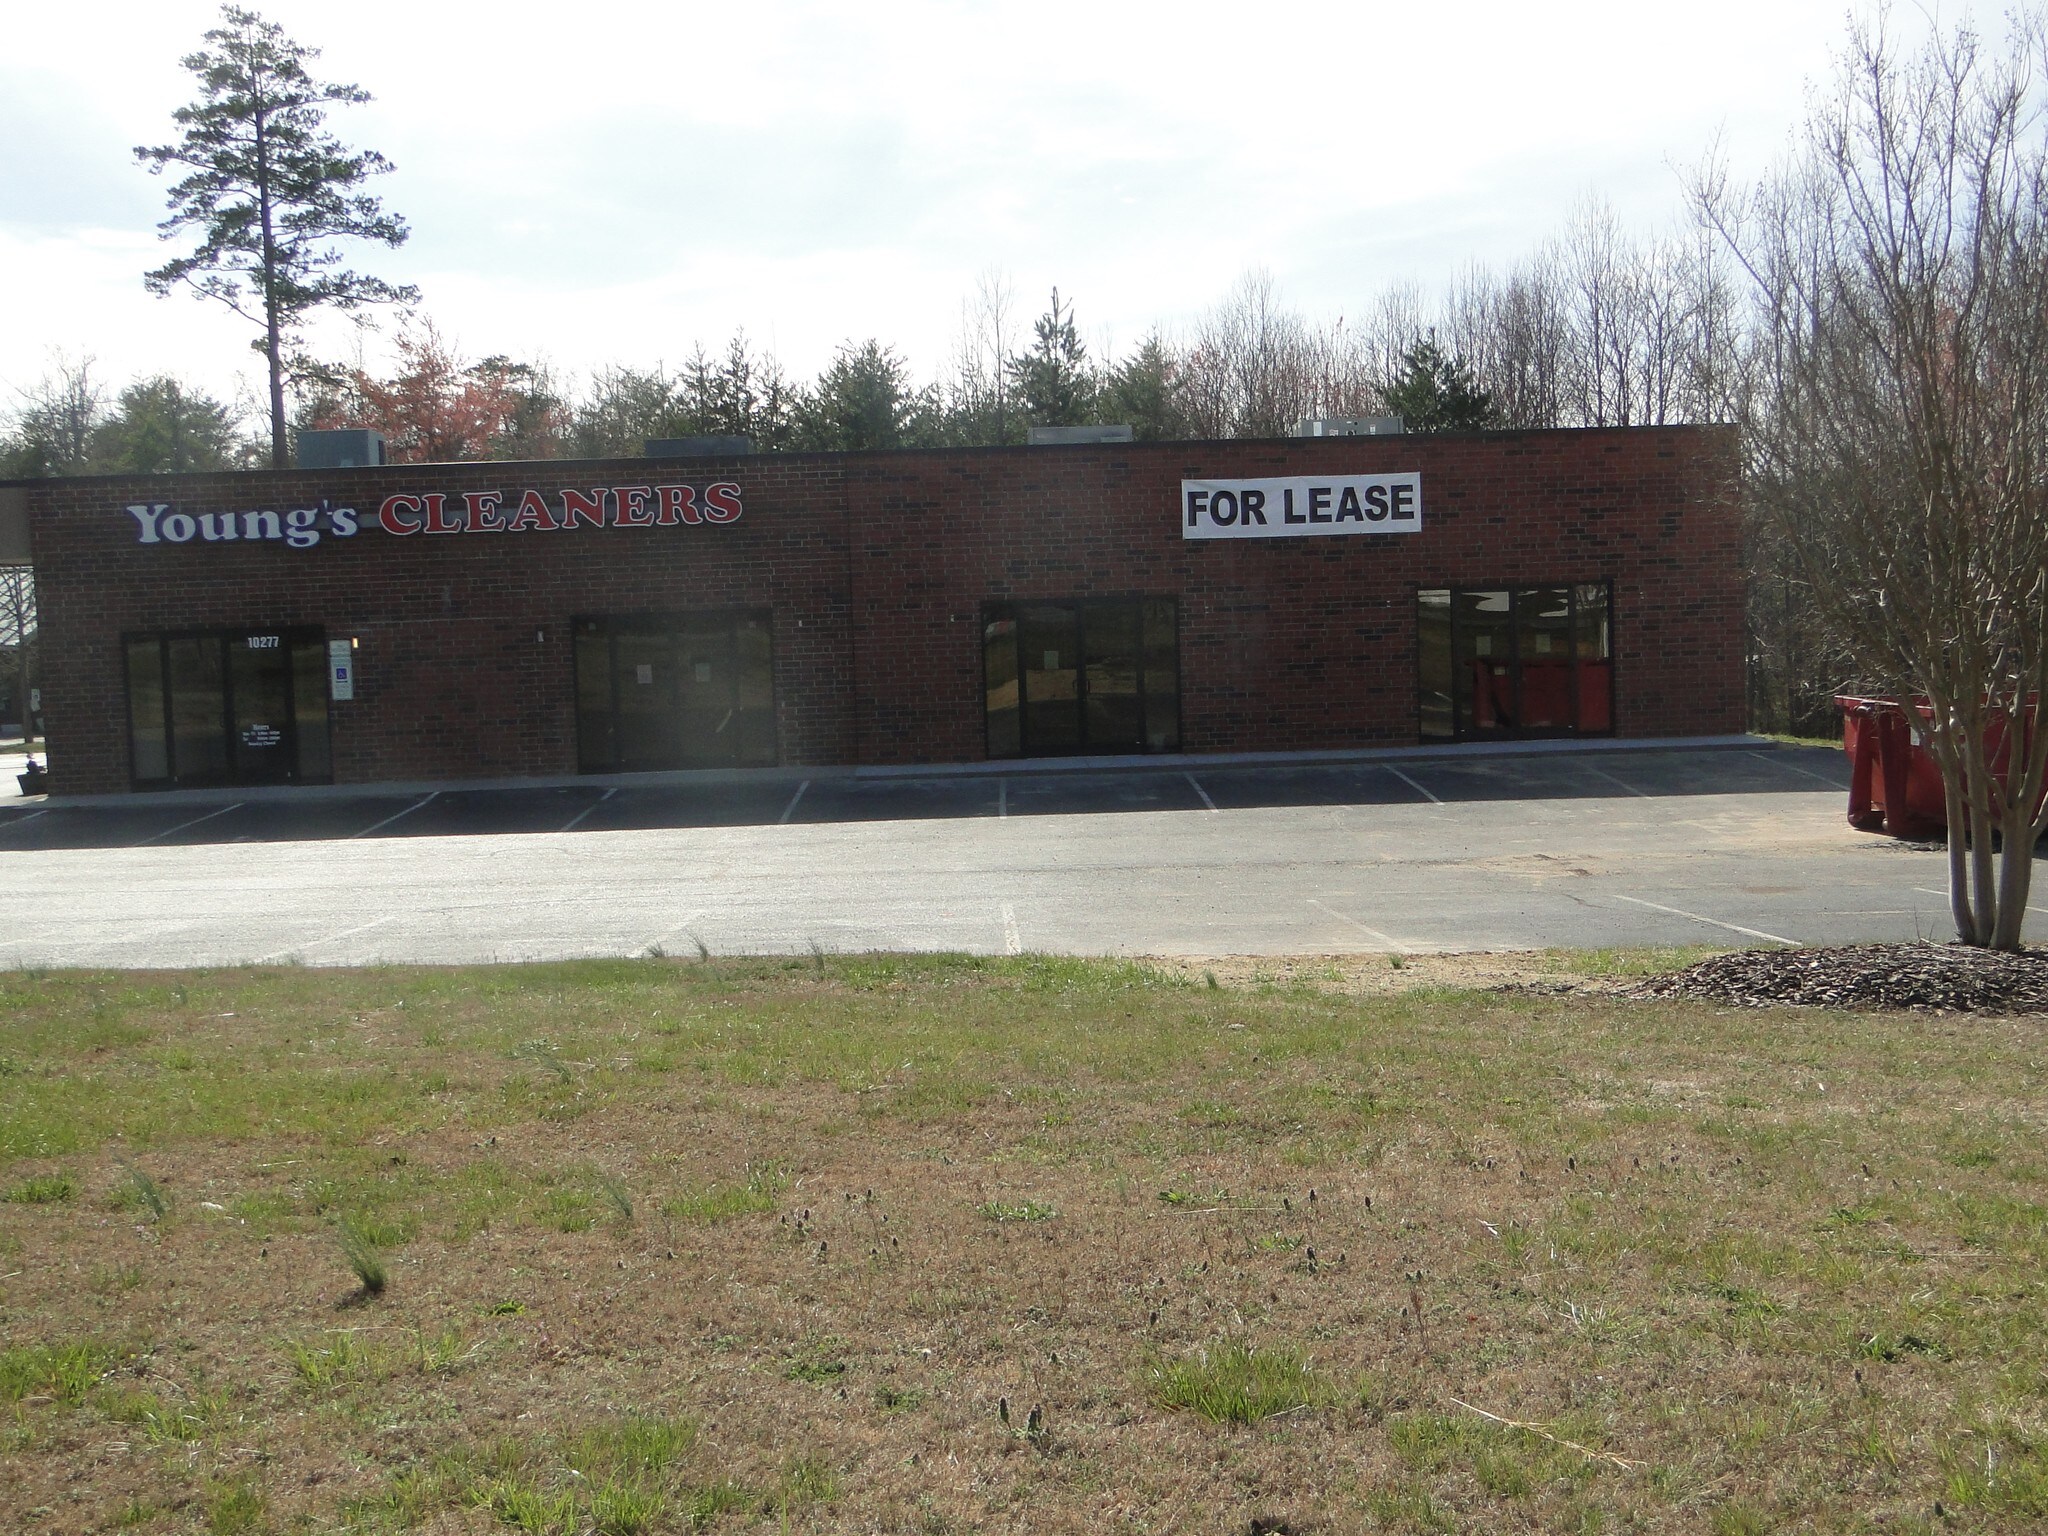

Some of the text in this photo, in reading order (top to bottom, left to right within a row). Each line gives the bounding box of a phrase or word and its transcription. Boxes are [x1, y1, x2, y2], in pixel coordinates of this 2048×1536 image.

[126, 483, 742, 547] Young's CLEANERS
[1187, 484, 1415, 527] FOR LEASE
[247, 636, 279, 648] 10277
